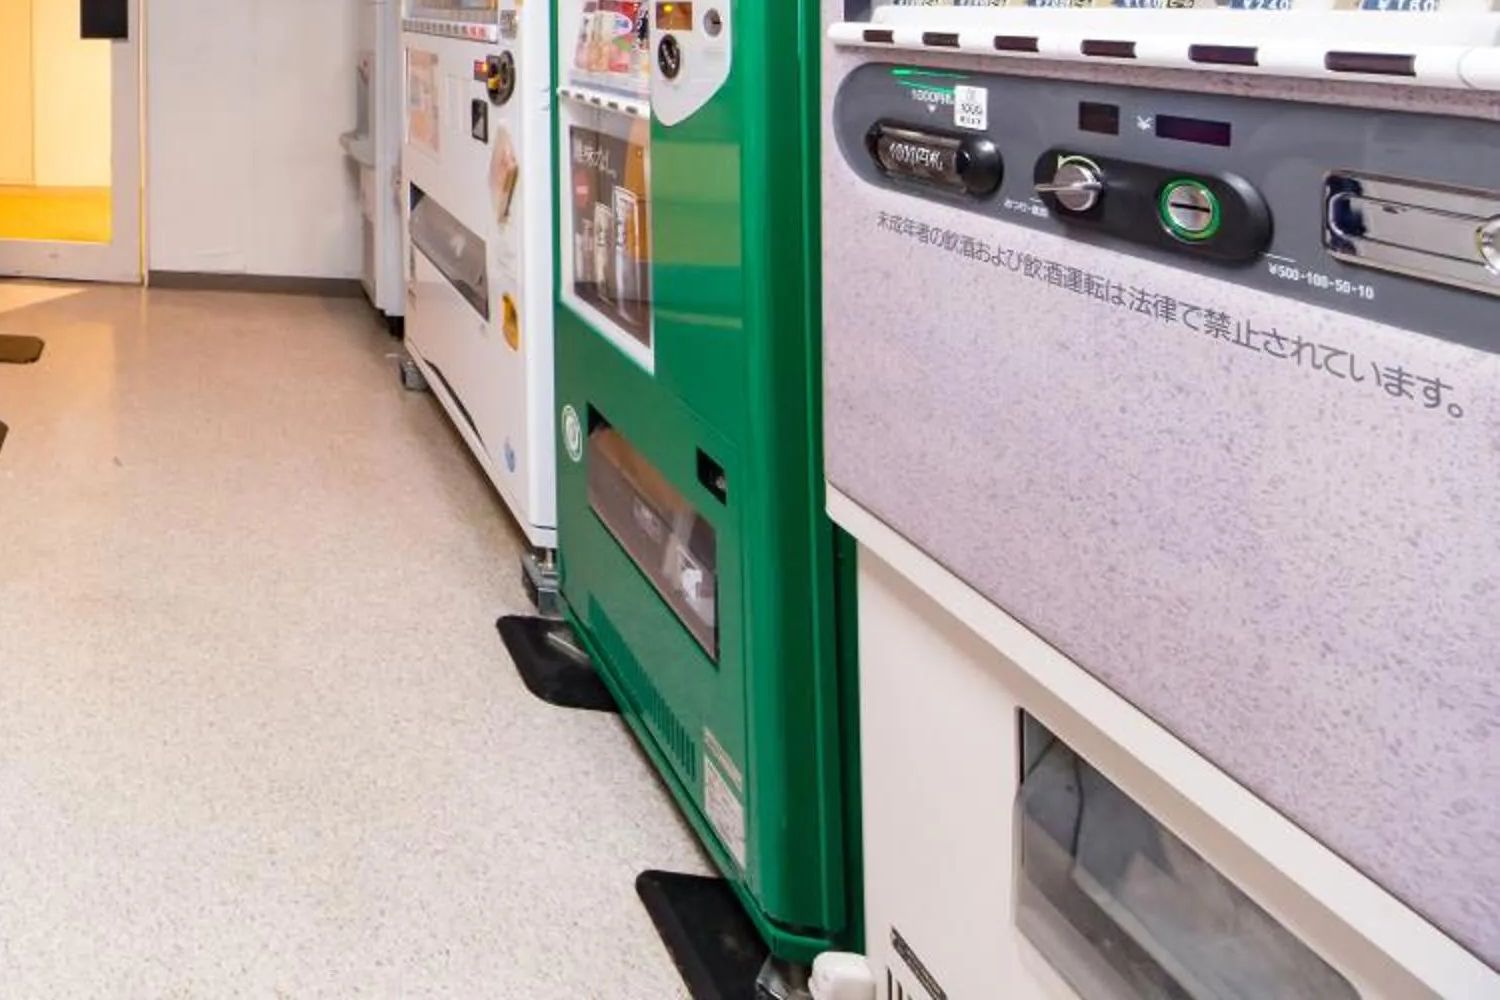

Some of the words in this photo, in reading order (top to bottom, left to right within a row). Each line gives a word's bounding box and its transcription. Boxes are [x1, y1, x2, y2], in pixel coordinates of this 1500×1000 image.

[877, 210, 1464, 418] 未成年者の飲酒および飲酒運転は法律で禁止されています。
